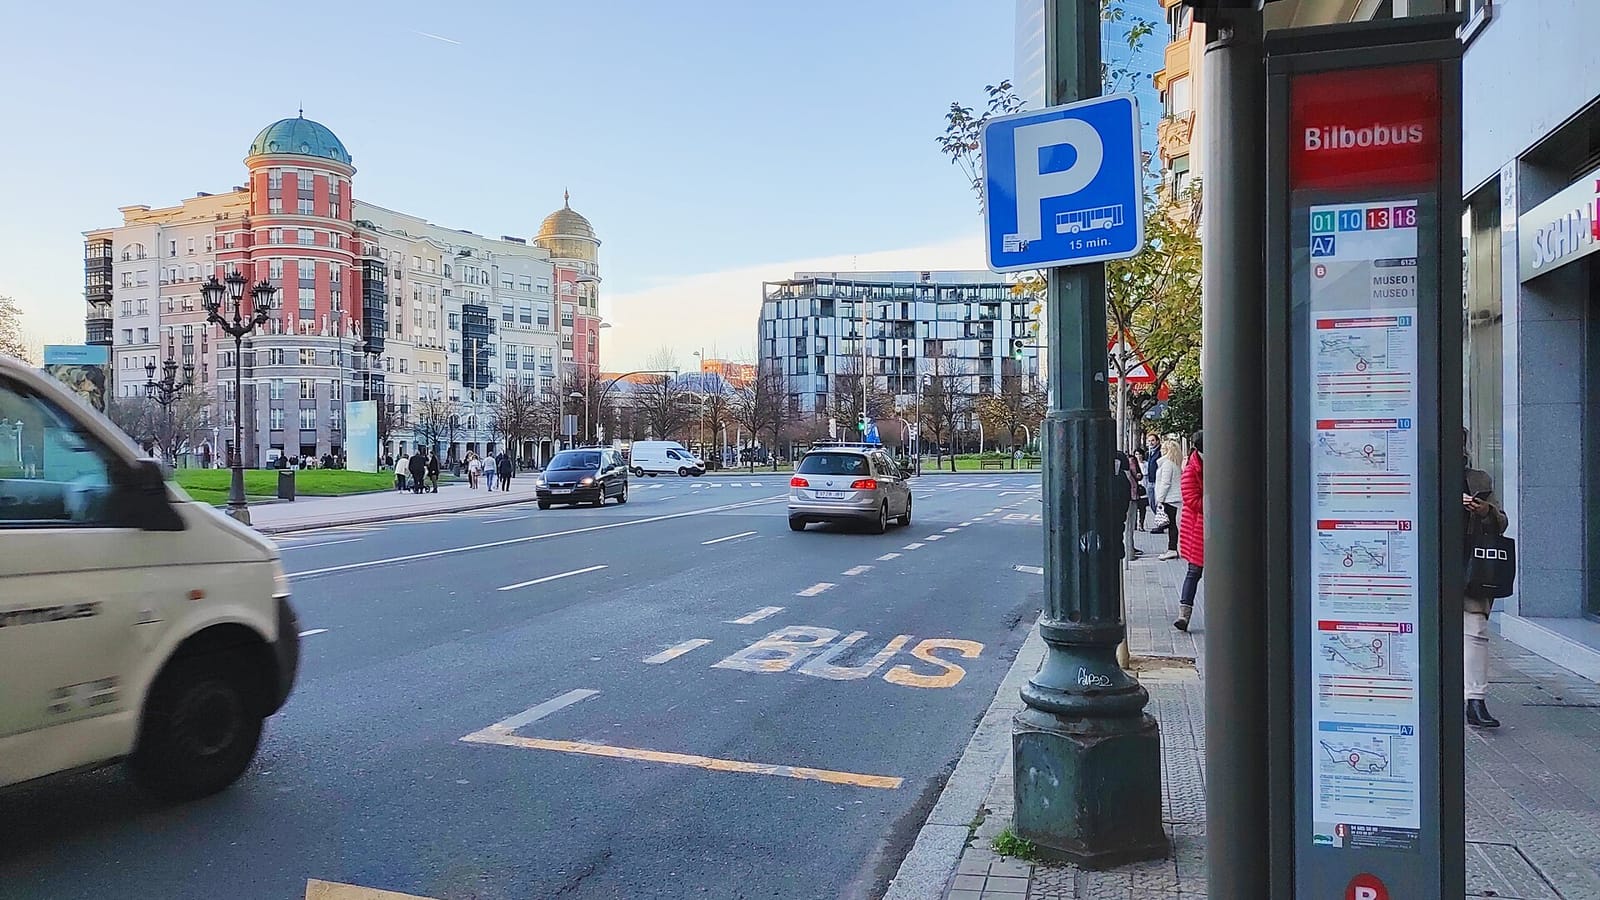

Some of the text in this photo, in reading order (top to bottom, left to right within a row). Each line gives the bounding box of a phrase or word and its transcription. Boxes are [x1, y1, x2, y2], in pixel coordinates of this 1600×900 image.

[1305, 123, 1423, 151] Bilbobus
[1014, 118, 1104, 242] P
[1313, 209, 1416, 231] 01 10 13 18
[1069, 237, 1112, 250] 15 min.
[1312, 237, 1334, 254] A7
[1373, 275, 1415, 285] MUSEO 1
[1373, 288, 1415, 298] MUSEO 1
[1400, 317, 1410, 326] 01
[1400, 419, 1410, 428] 10
[1400, 521, 1411, 530] 13
[1401, 623, 1412, 633] 18
[710, 625, 985, 689] BUS
[1400, 725, 1413, 736] A7
